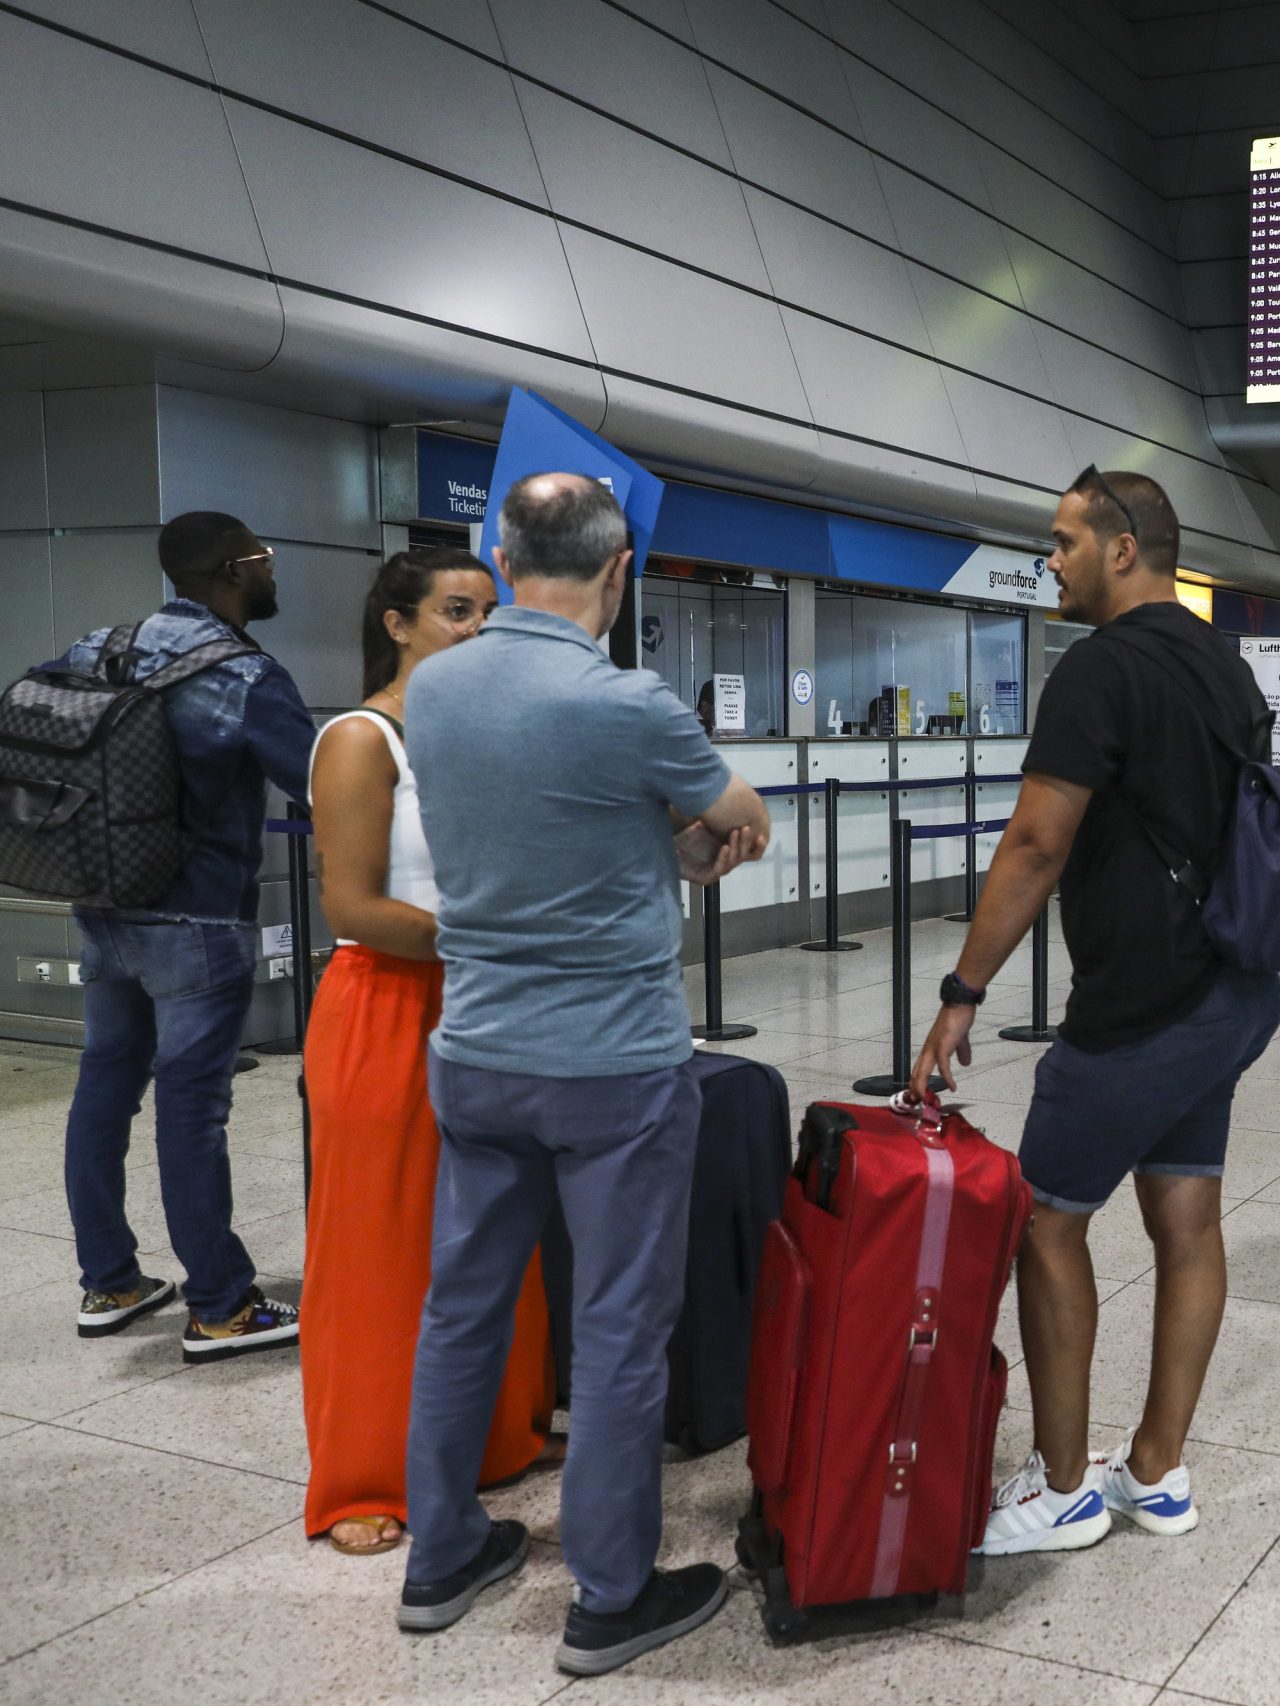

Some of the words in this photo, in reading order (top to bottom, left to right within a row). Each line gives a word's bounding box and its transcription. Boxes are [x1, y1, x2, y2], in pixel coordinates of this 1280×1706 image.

[448, 480, 487, 500] Vendas
[989, 569, 1037, 588] groundforce
[1016, 591, 1037, 600] PORTUGAL
[828, 700, 843, 735] 4
[916, 700, 925, 734] 5
[979, 704, 990, 734] 6
